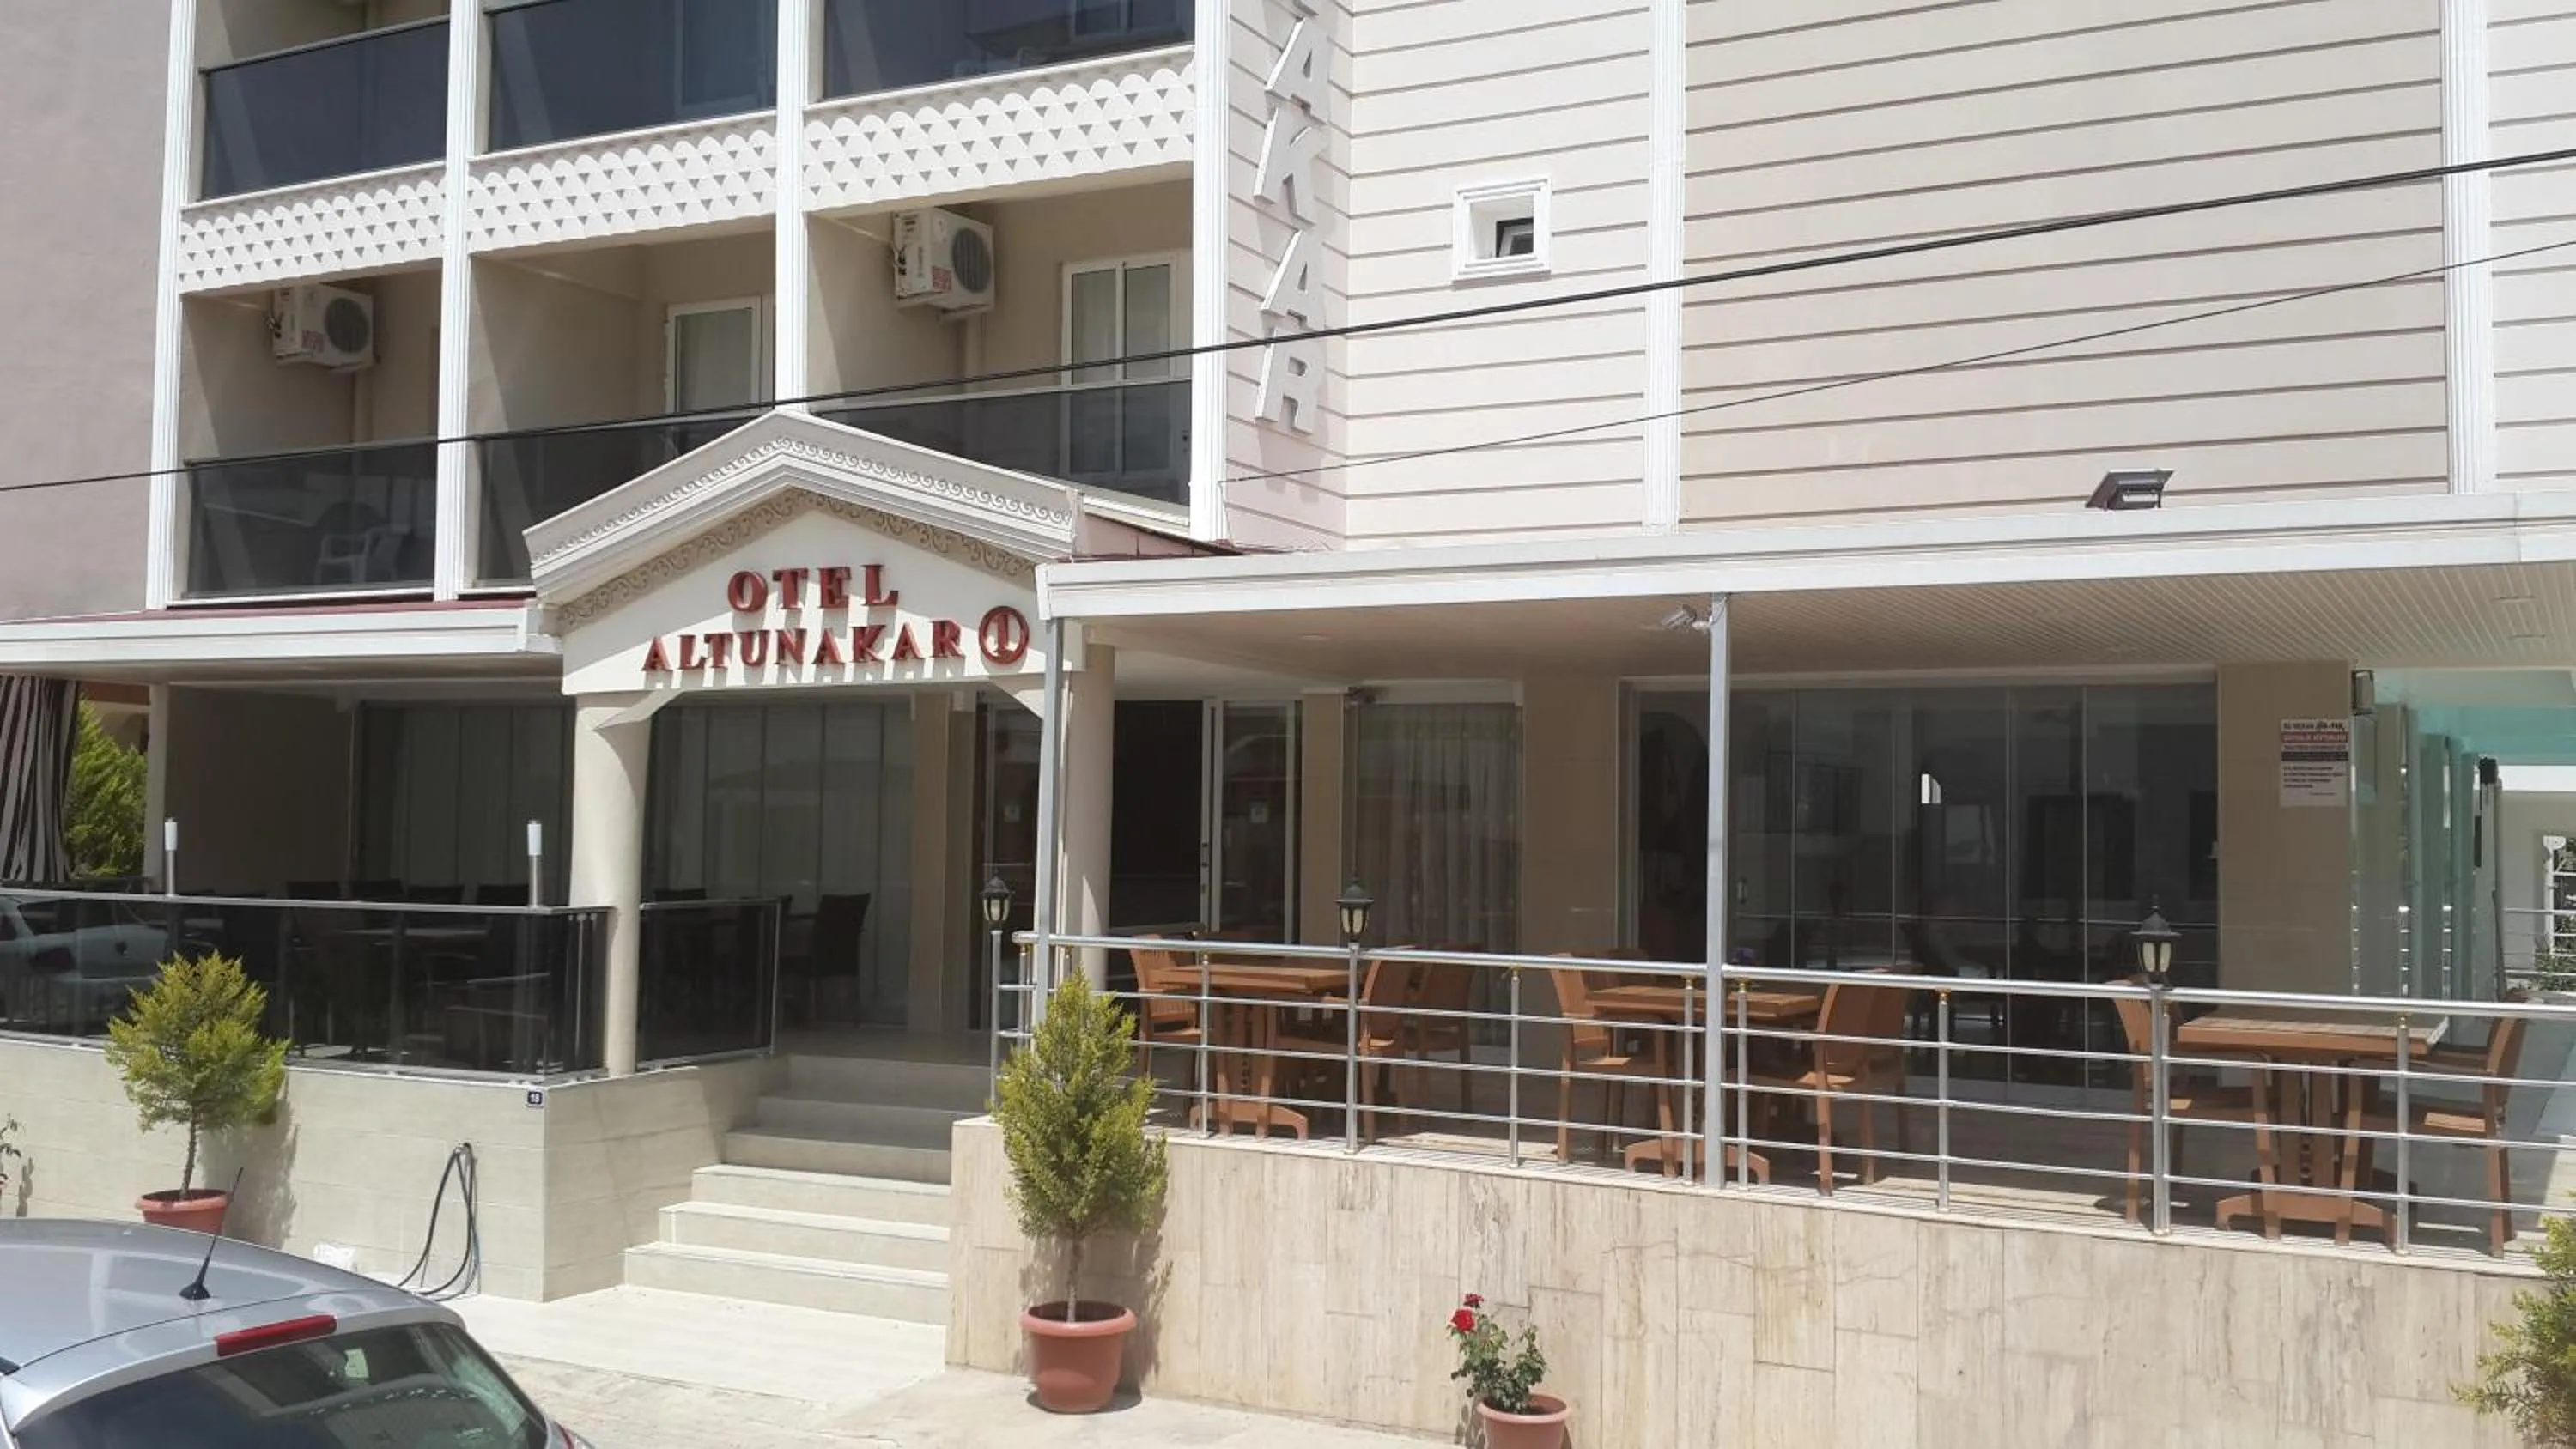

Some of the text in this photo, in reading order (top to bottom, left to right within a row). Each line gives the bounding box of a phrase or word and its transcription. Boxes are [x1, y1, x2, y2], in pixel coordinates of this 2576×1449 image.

[1254, 0, 1328, 435] AKAR
[727, 564, 899, 613] OTEL
[641, 620, 963, 671] ALTUNAKAR
